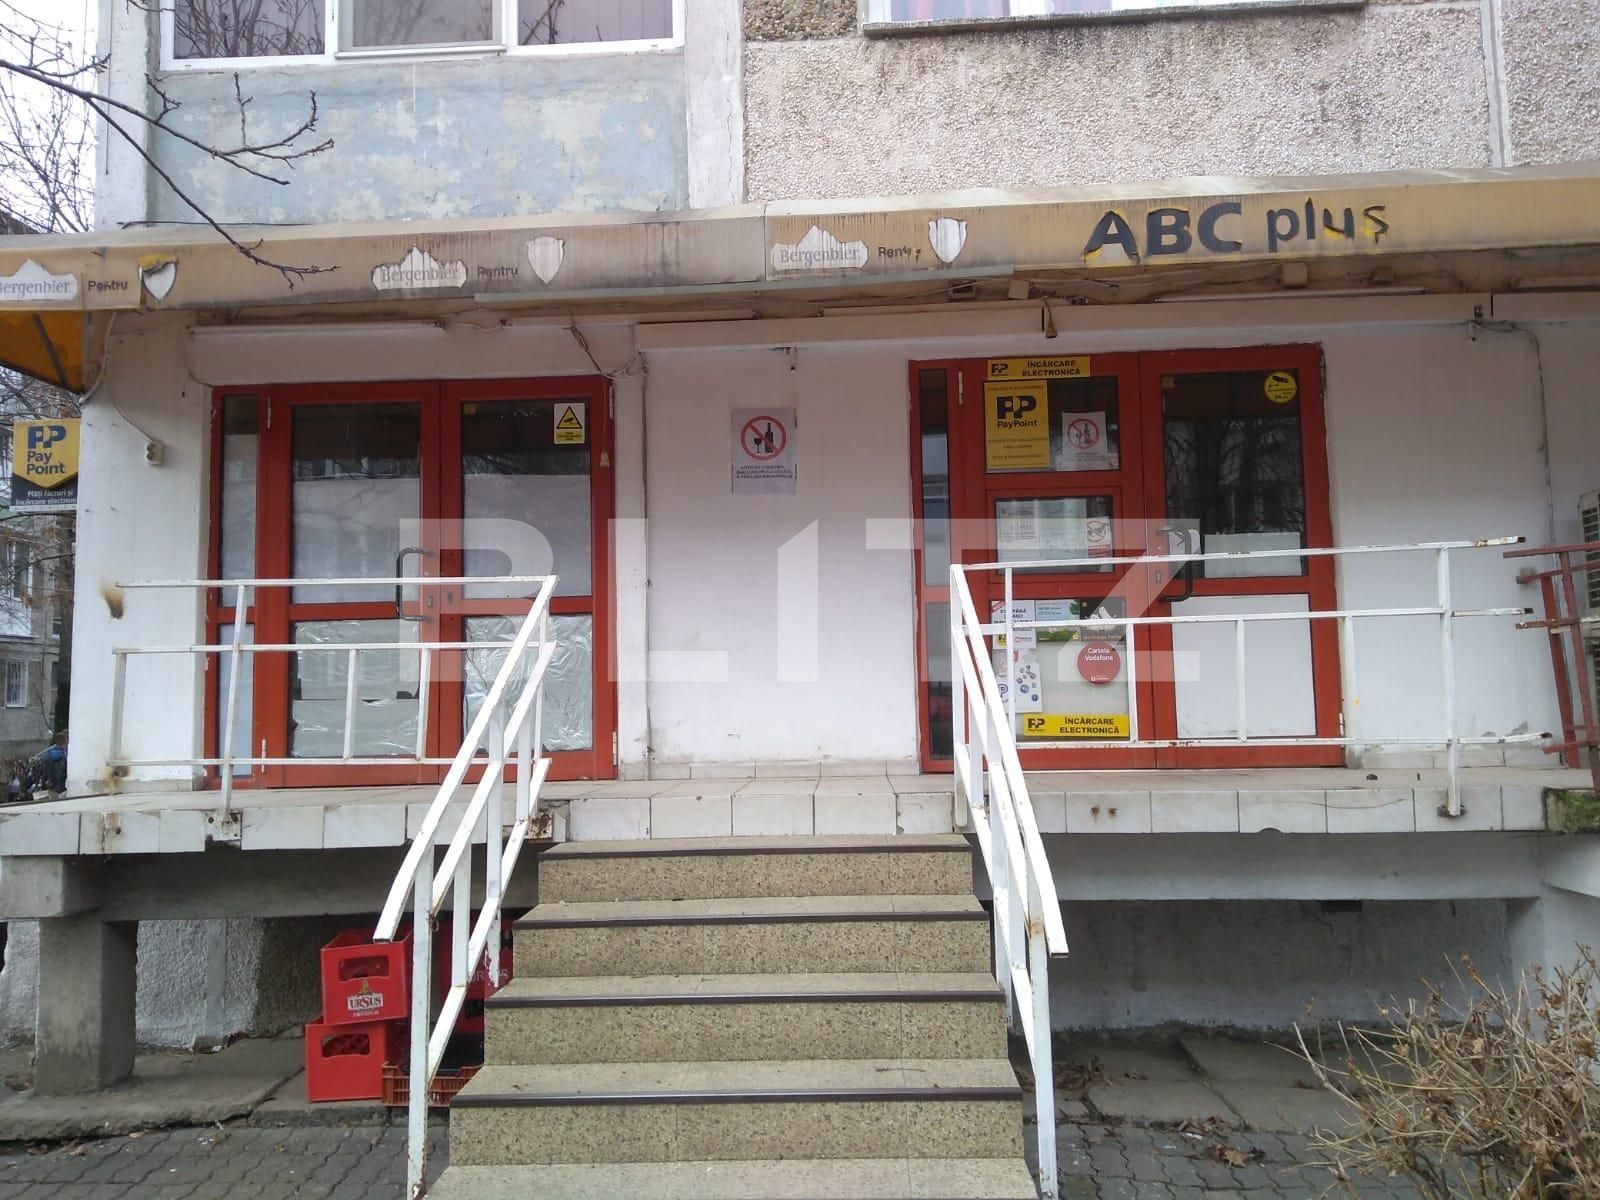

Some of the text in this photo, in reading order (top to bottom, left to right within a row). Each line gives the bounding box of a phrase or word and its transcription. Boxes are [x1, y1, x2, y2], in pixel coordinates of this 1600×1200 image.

[1082, 202, 1242, 264] ABC
[780, 247, 859, 267] Bergenbier
[380, 264, 458, 286] Bergenbier
[997, 419, 1038, 429] PayPoint
[28, 450, 53, 464] Pay
[27, 462, 66, 475] Point
[350, 996, 382, 1009] URSUS
